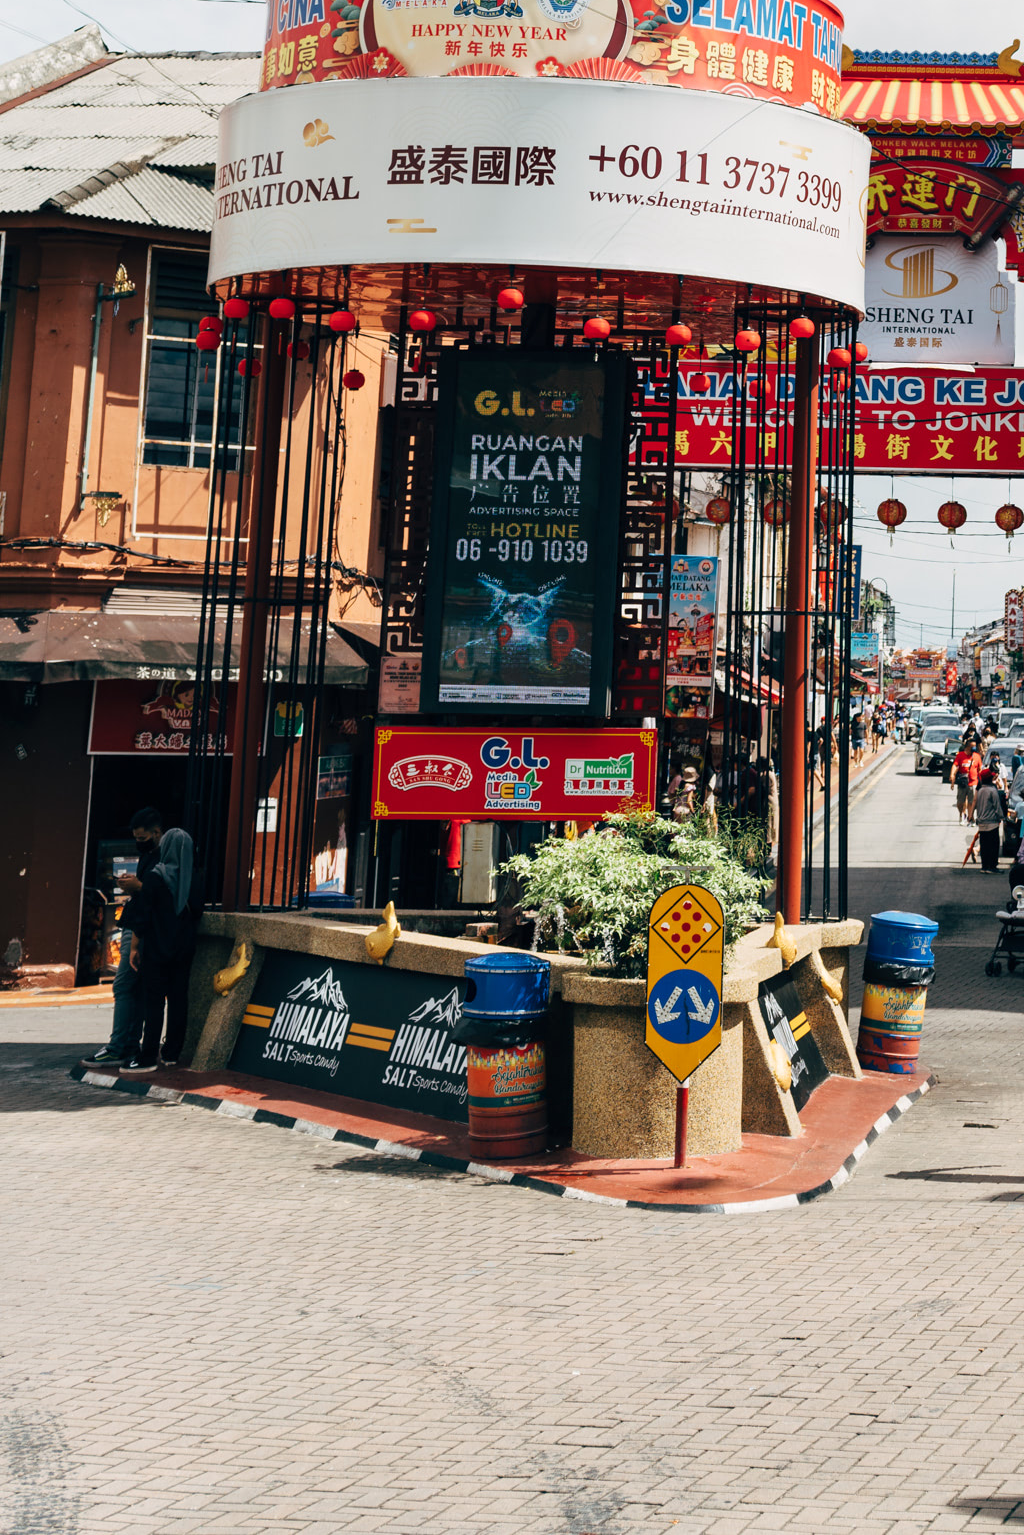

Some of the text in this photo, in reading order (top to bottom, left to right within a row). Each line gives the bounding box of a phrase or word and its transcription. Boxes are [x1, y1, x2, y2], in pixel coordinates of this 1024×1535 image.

[395, 0, 447, 8] MELAKA
[411, 24, 567, 41] HAPPY NEW YEAR
[445, 40, 528, 58] 新年快乐
[263, 35, 319, 87] 事如意
[667, 36, 794, 93] 身體健康
[251, 151, 284, 178] TAI
[387, 145, 556, 186] 盛泰國際
[588, 144, 842, 213] +60 11 3737 3399
[589, 190, 840, 239] www.shengtaiinternational.com
[898, 218, 942, 229] 恭喜發財
[865, 307, 974, 324] SHENG TAI
[882, 326, 955, 334] INTERNATIONAL
[893, 337, 943, 348] 盛泰国际
[934, 377, 986, 405] KE
[474, 390, 535, 416] G.L.
[871, 410, 917, 430] TO
[471, 434, 583, 452] RUANGAN
[469, 454, 582, 481] IKLAN
[468, 506, 580, 517] ADVERTISING SPACE
[490, 523, 580, 538] HOTLINE
[456, 538, 588, 563] 06 -910 1039
[670, 582, 710, 591] MELAKA
[136, 666, 176, 680] 茶の道
[481, 737, 549, 769] G.L.
[407, 761, 455, 776] 三叔公
[487, 772, 517, 781] Media
[569, 764, 628, 775] Dr Nutrition
[486, 782, 531, 799] LED
[485, 799, 541, 811] Advertising
[269, 1002, 350, 1051] HIMALAYA
[262, 1040, 340, 1077] SALT Sports Candy
[382, 1065, 468, 1105] SALT Sports Candy
